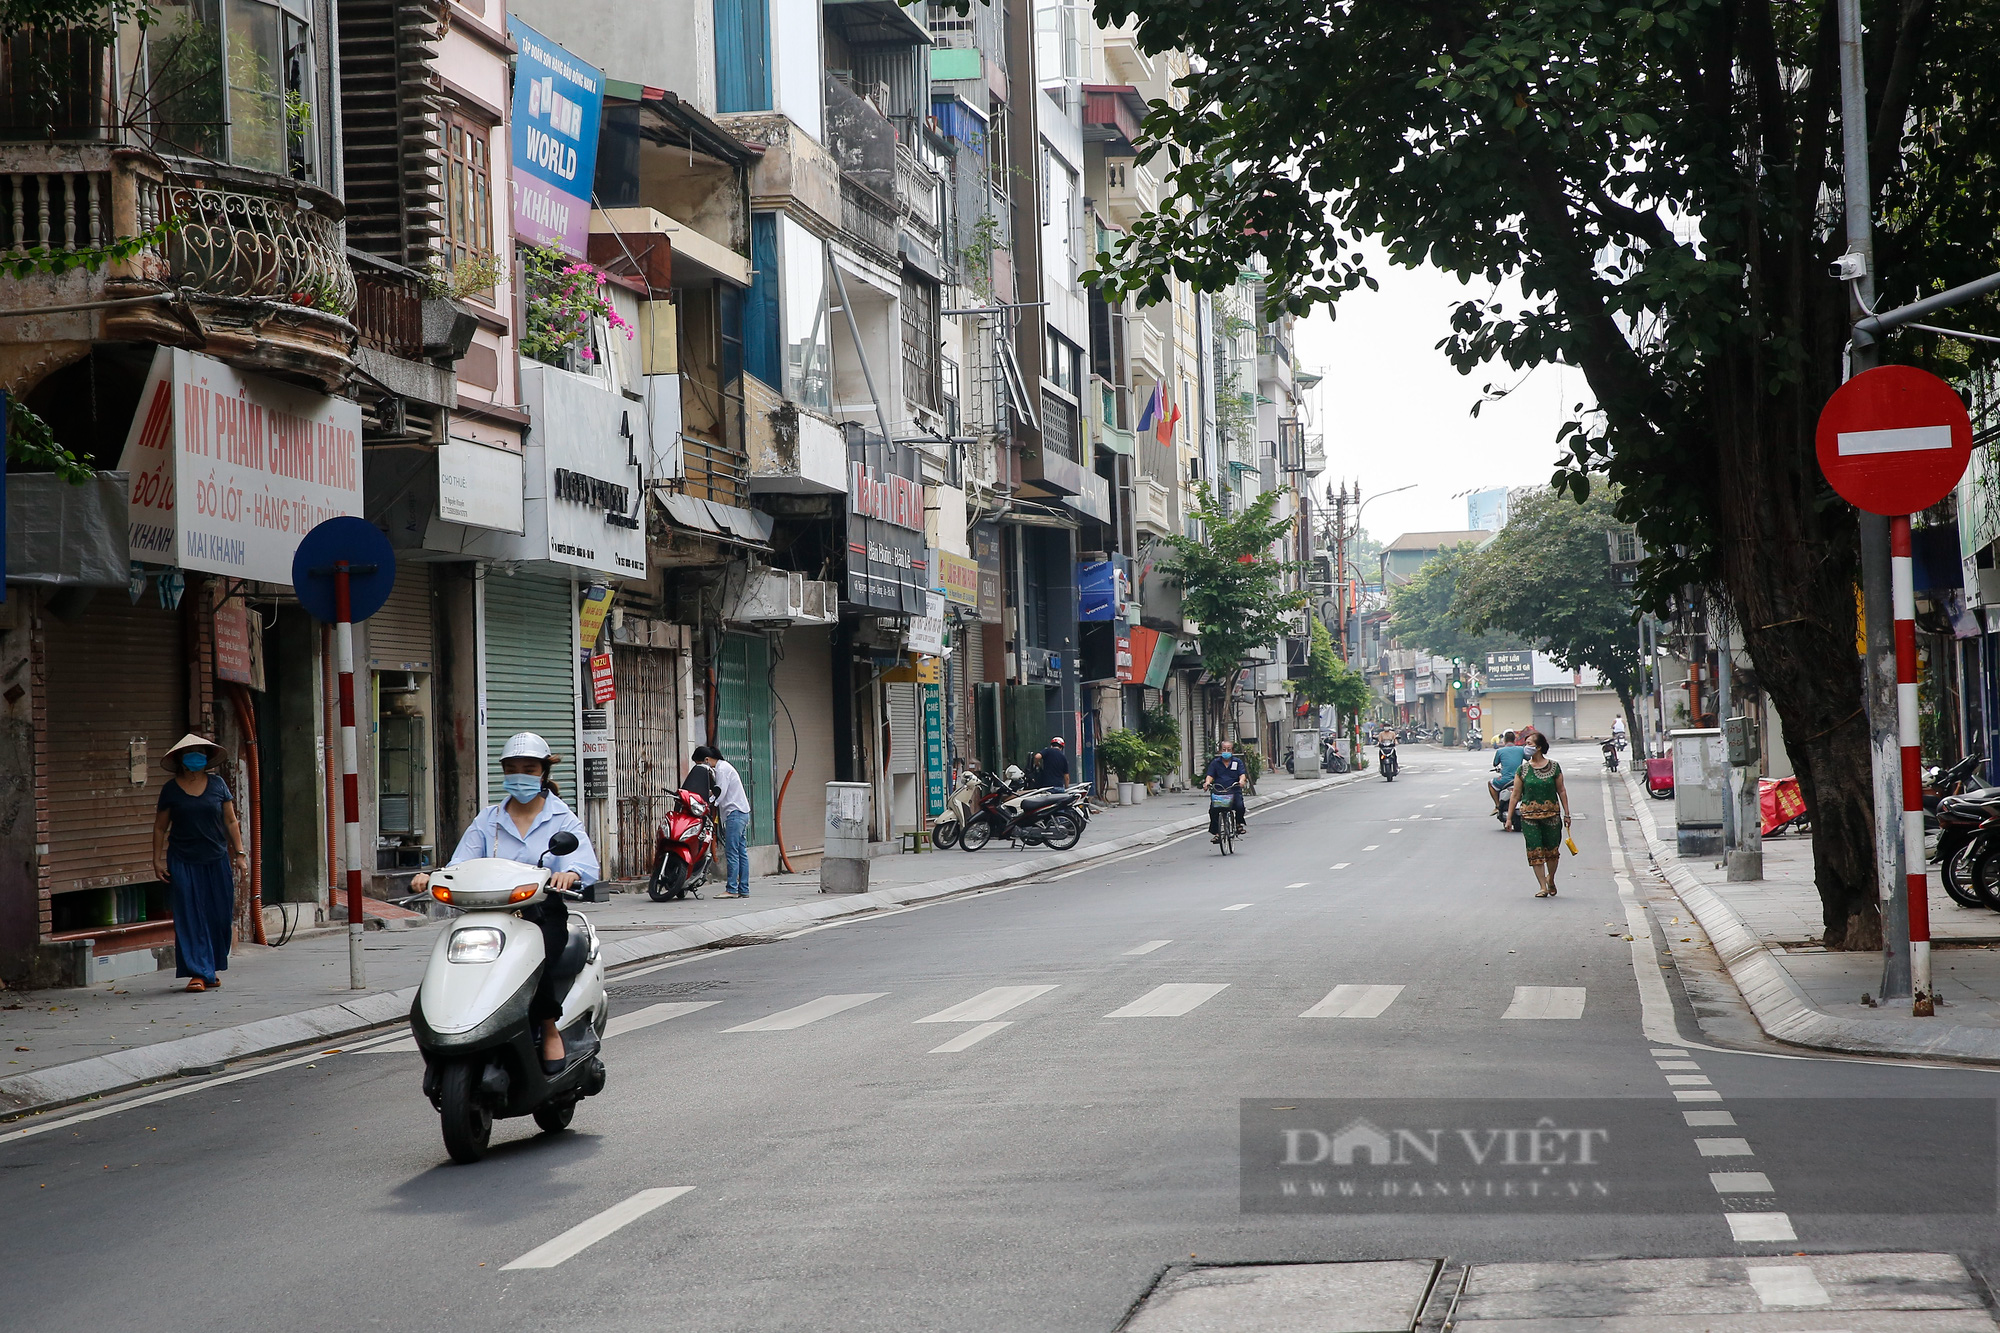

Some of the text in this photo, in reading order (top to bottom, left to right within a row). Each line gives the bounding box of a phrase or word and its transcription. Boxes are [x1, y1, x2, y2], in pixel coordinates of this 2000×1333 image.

[529, 77, 582, 141] COLOR
[526, 125, 577, 181] WORLD
[521, 187, 569, 236] KHÁNH
[184, 376, 356, 492] MỸ PHẨM CHÍNH HÃNG
[441, 473, 453, 485] CHO
[196, 467, 217, 518] ĐỒ
[221, 476, 243, 523] LÓT
[254, 483, 290, 532] HÀNG
[130, 523, 174, 553] KHANH
[187, 530, 245, 566] MAI KHANH
[868, 540, 878, 562] Bán
[894, 547, 904, 568] Bán
[926, 702, 939, 712] CHÈ
[930, 784, 942, 795] CÁC
[931, 799, 942, 810] LOẠI
